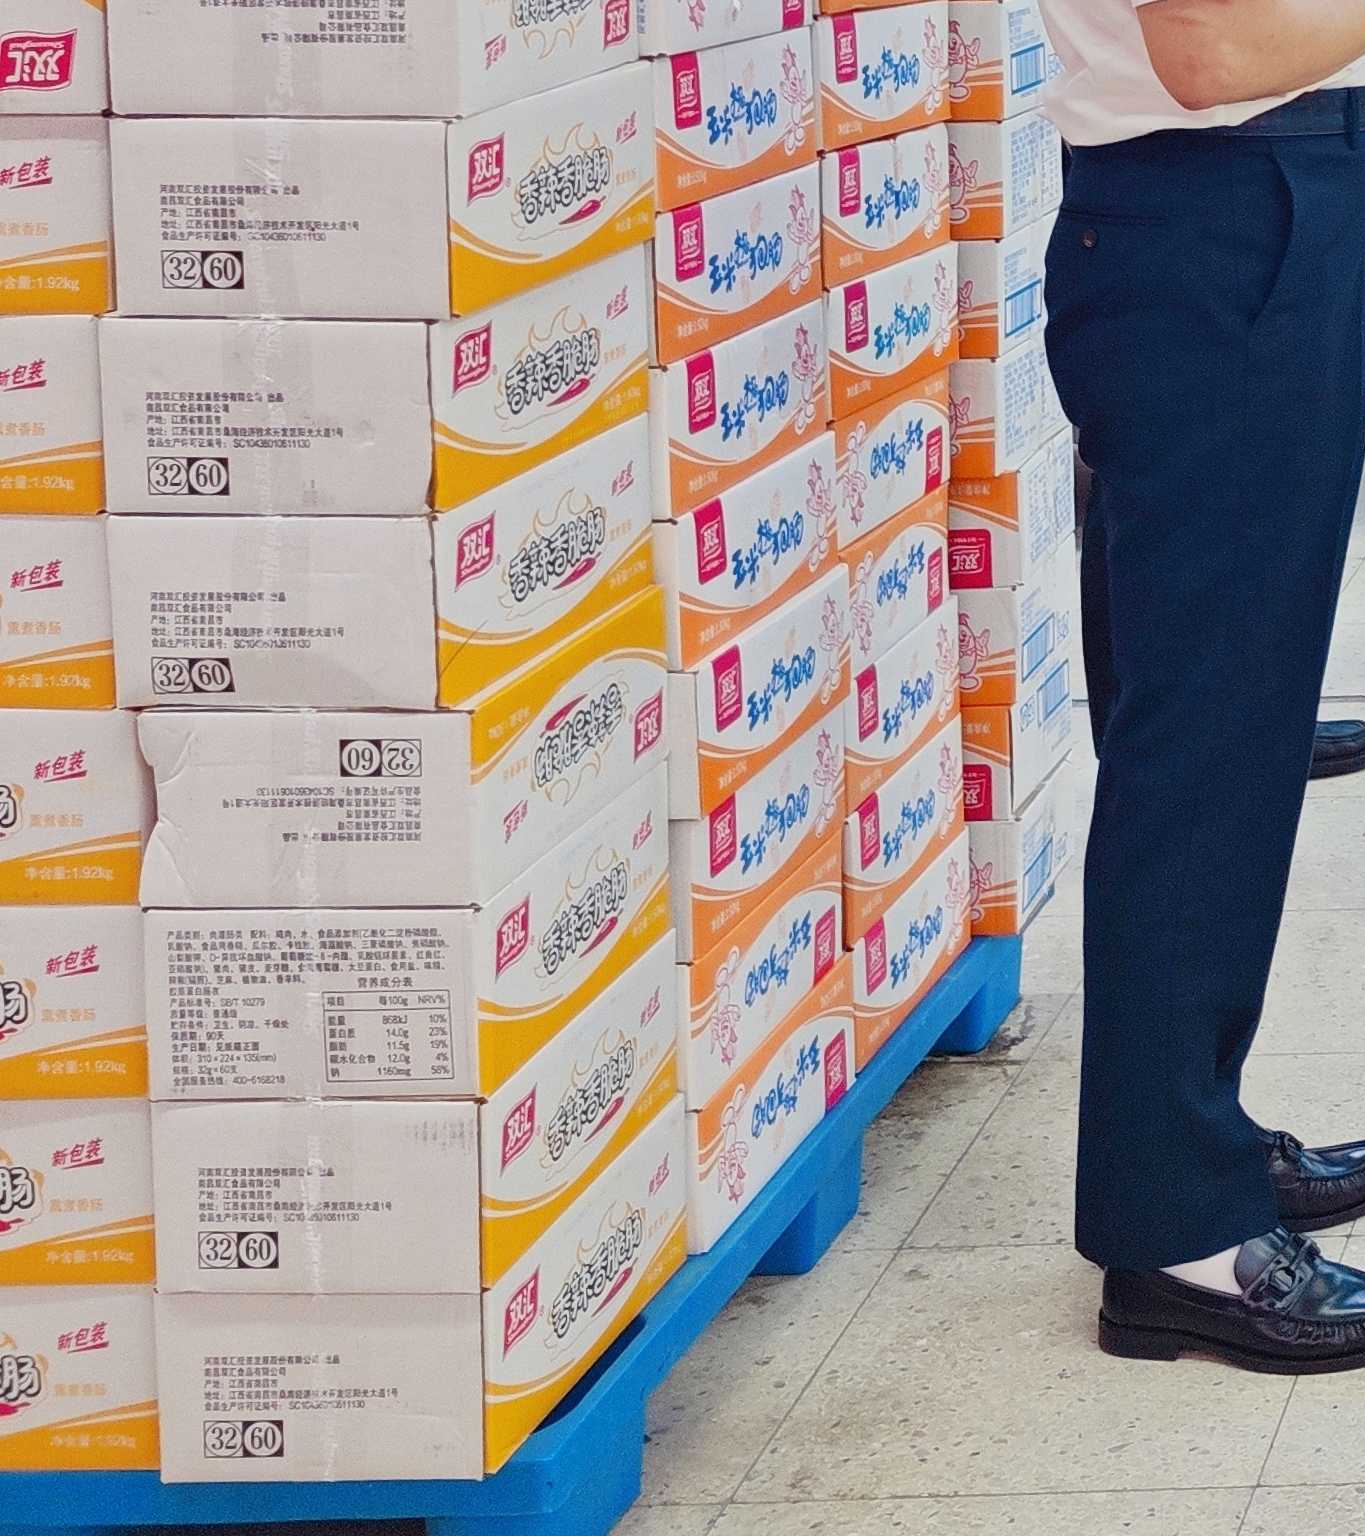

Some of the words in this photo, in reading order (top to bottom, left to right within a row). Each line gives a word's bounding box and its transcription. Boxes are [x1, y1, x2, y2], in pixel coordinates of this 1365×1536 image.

[6, 47, 67, 84] 双汇
[0, 156, 52, 186] 新包装
[519, 146, 610, 224] 香辣香脆肠
[170, 256, 198, 281] 32
[209, 256, 237, 281] 60
[505, 328, 600, 414] 香辣香脆肠
[155, 463, 182, 488] 32
[194, 464, 221, 488] 60
[509, 507, 605, 601] 香辣香脆肠
[10, 559, 63, 588] 新包装
[158, 663, 185, 687] 32
[198, 663, 224, 687] 60
[33, 749, 87, 780] 新包装
[347, 746, 374, 770] 60
[386, 746, 414, 770] 32
[540, 862, 628, 975] 香辣香脆肠
[45, 944, 98, 976] 新包装
[548, 1040, 636, 1160] 香辣香脆肠
[52, 1137, 104, 1167] 新包装
[205, 1237, 232, 1262] 32
[245, 1237, 271, 1262] 60
[550, 1209, 642, 1338] 香辣香脆肠
[57, 1321, 108, 1352] 新包装
[210, 1426, 238, 1451] 32
[250, 1426, 276, 1450] 60
